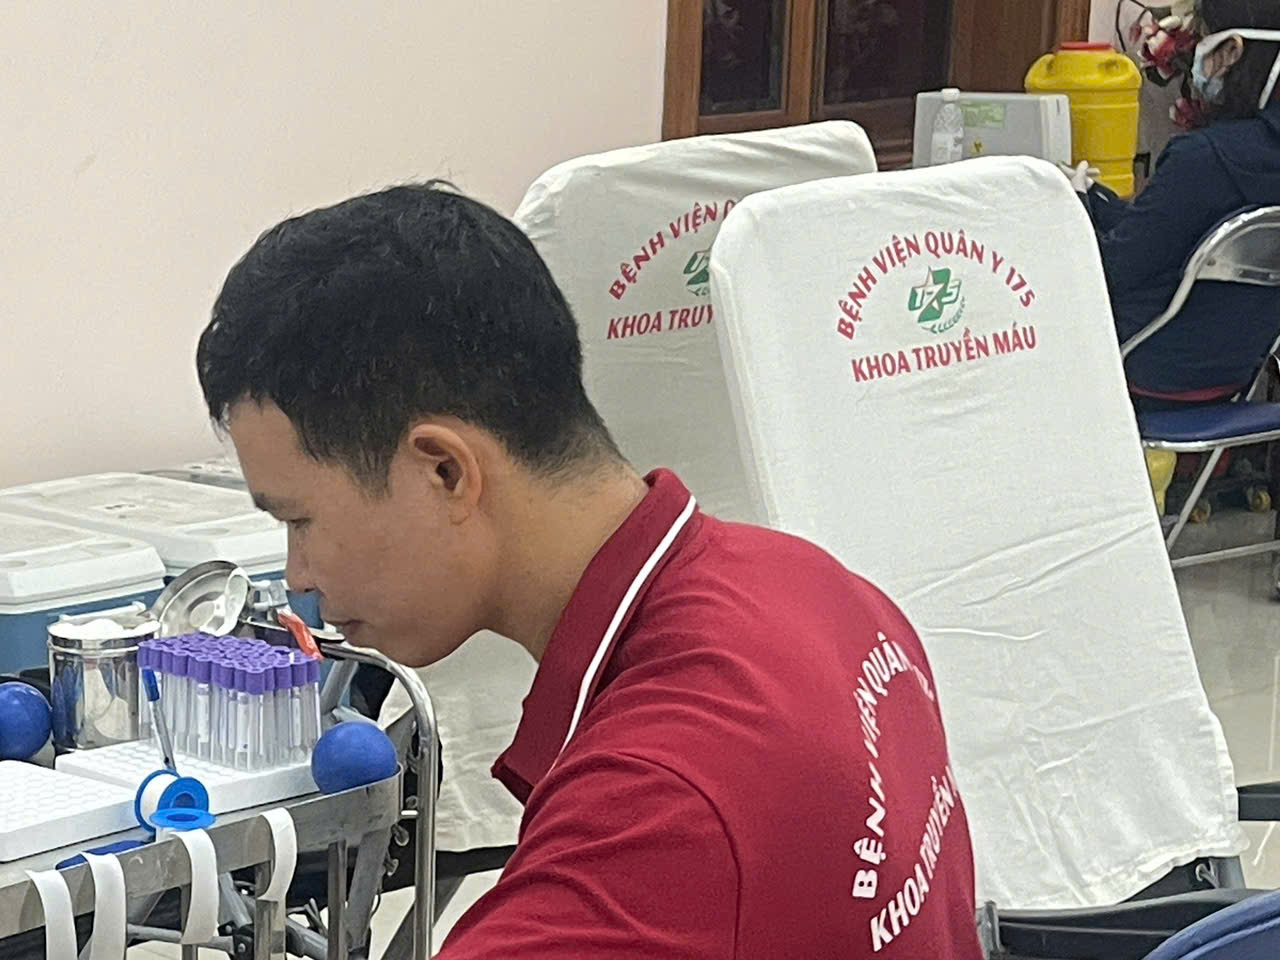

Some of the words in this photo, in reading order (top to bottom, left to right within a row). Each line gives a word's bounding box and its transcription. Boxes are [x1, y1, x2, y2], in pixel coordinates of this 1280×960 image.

[609, 231, 665, 300] BỆNH
[669, 201, 718, 239] VIỆN
[837, 266, 878, 340] BỆNH
[872, 234, 921, 275] VIỆN
[924, 228, 985, 264] QUÂN
[992, 250, 1004, 273] Y
[1005, 266, 1036, 308] 175
[607, 310, 663, 340] KHOA
[851, 350, 911, 383] KHOA
[912, 327, 990, 371] TRUYỀN
[991, 321, 1036, 355] MÁU
[870, 863, 930, 953] KHOA
